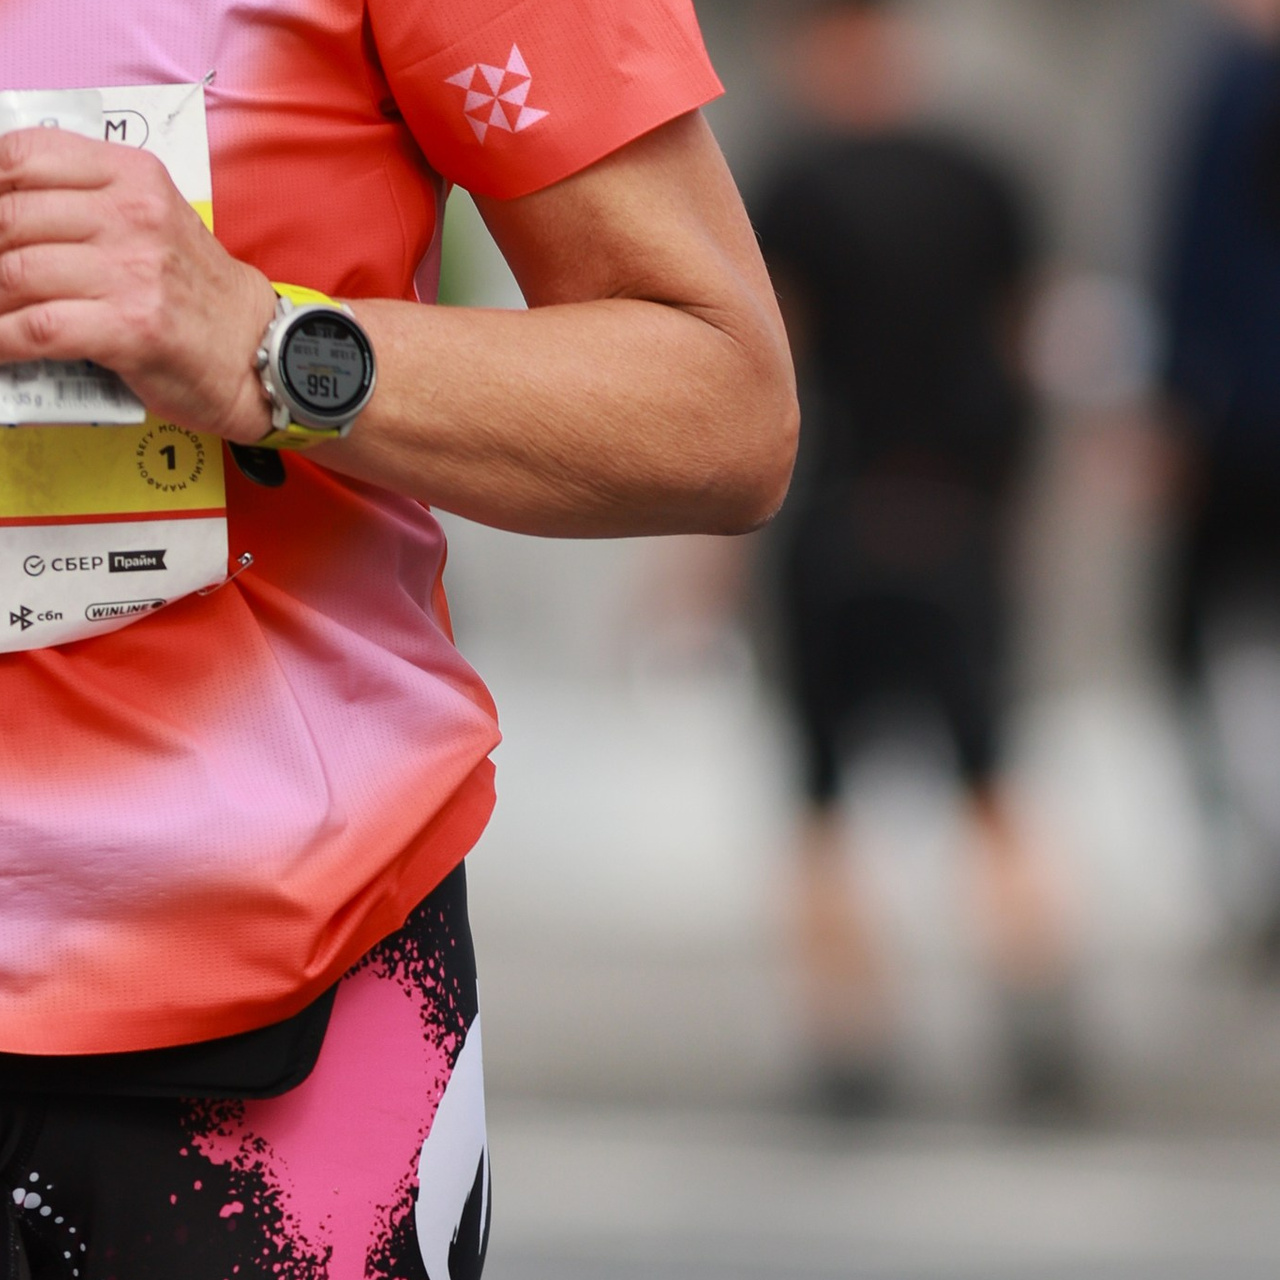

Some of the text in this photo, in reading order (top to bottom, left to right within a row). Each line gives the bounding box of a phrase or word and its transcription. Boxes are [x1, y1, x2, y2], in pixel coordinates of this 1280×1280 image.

[159, 445, 176, 470] 1
[136, 461, 187, 492] МАРАФОН
[51, 555, 157, 571] СБЕР Прайм
[37, 610, 63, 621] сбп
[92, 603, 150, 618] WINLINE
